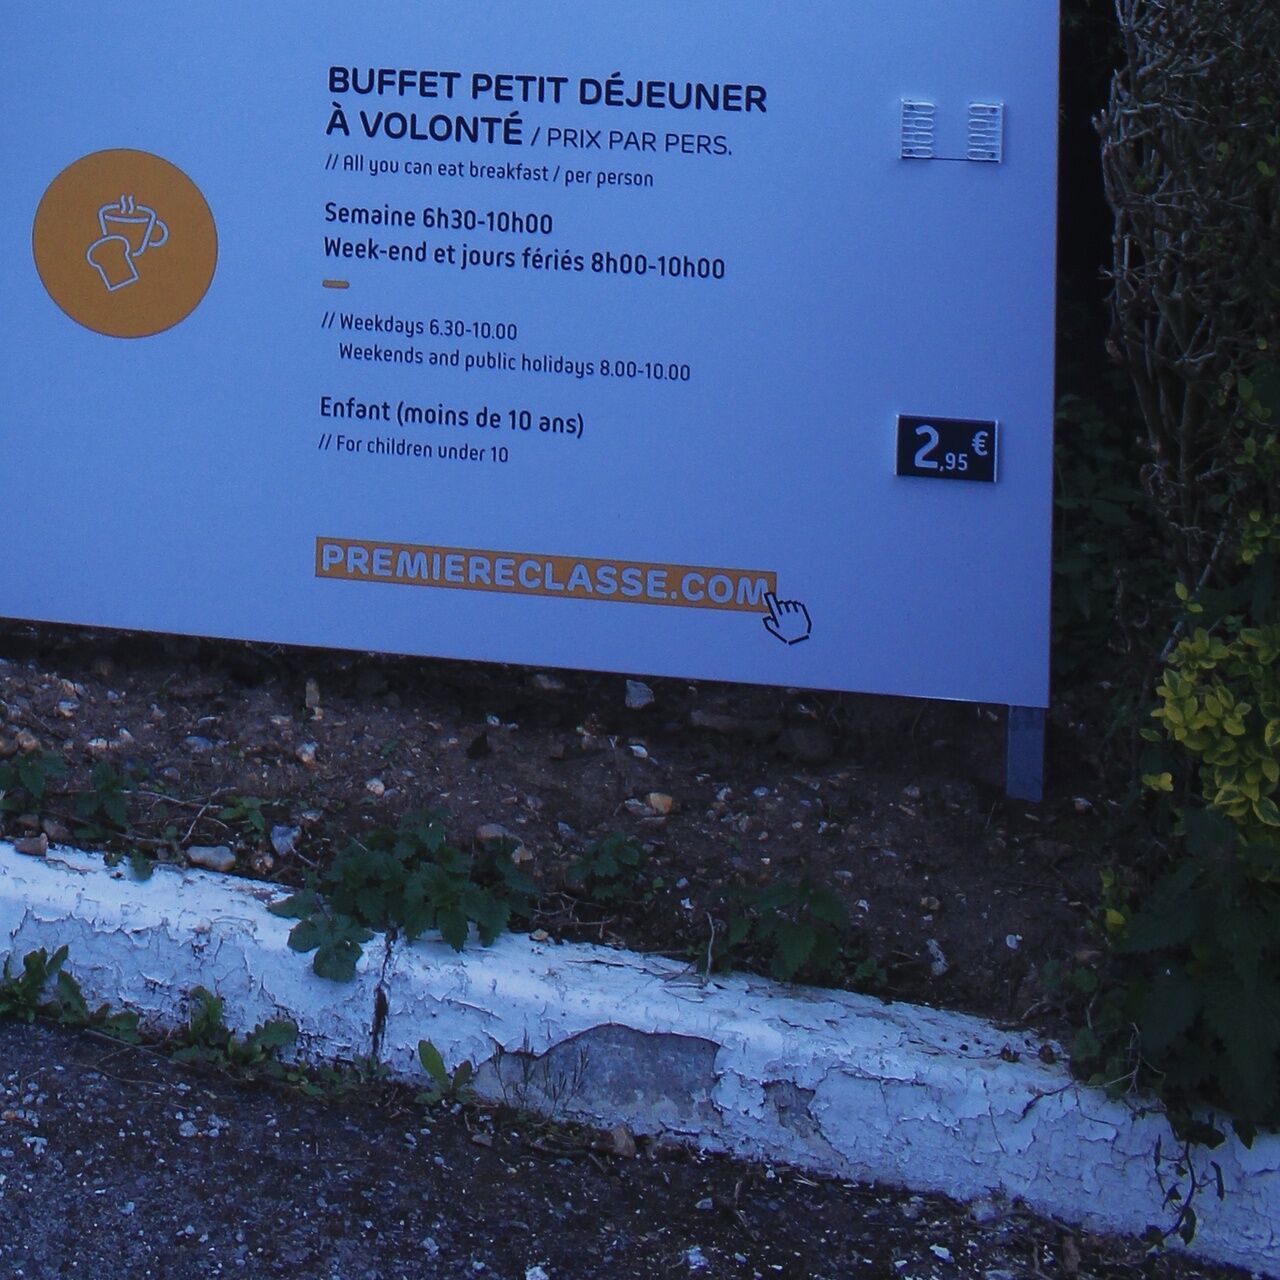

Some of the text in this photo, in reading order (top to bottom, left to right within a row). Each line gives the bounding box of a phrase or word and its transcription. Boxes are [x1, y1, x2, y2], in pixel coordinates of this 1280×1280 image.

[328, 65, 767, 114] BUFFET PETIT DÉJEUNER
[325, 101, 351, 138] À
[359, 109, 523, 146] VOLONTÉ
[547, 127, 602, 150] PRIX
[609, 129, 657, 152] PAR
[665, 133, 732, 157] PERS.
[343, 153, 364, 172] All
[369, 159, 399, 177] you
[404, 161, 433, 176] can
[437, 161, 465, 178] eat
[469, 159, 549, 183] breakfast
[564, 169, 593, 188] per
[596, 171, 654, 189] person
[324, 201, 553, 236] Semaine 6h30-10h00
[324, 235, 725, 280] Week-end et jours fériés 8h00-10h00
[339, 312, 425, 339] Weekdays
[429, 318, 518, 342] 6.30-10.00
[339, 341, 691, 382] Weekends and public holidays 8.00-10.00
[320, 395, 584, 440] Enfant (moins de 10 ans)
[336, 433, 363, 453] For
[367, 436, 433, 459] children
[437, 442, 486, 462] under
[490, 445, 509, 464] 10
[320, 543, 770, 607] PREMIERECLASSE.COM
